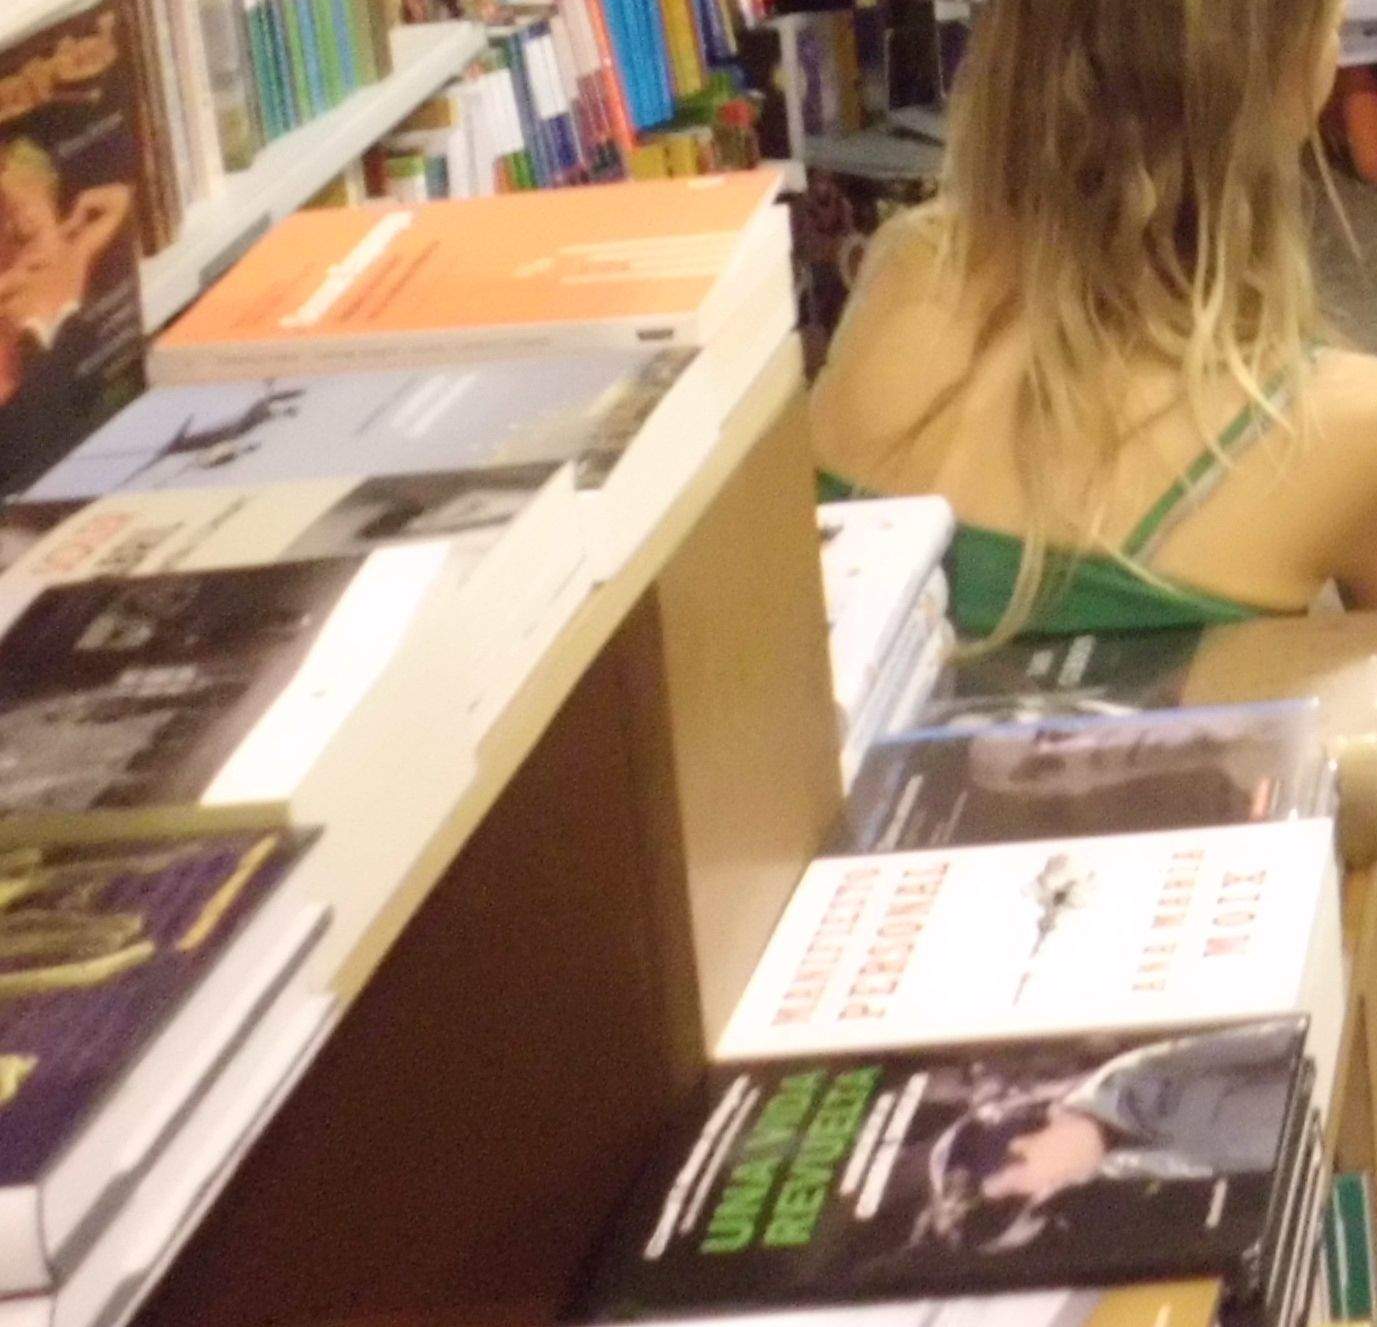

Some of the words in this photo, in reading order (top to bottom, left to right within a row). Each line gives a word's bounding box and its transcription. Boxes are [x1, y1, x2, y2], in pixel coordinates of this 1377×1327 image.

[836, 862, 951, 1021] PERSONAL
[1131, 942, 1178, 992] ANA
[1203, 869, 1267, 958] MOIX
[700, 1155, 783, 1255] UNA
[743, 1069, 829, 1155] VIDA
[762, 1065, 884, 1247] REVUELTA
